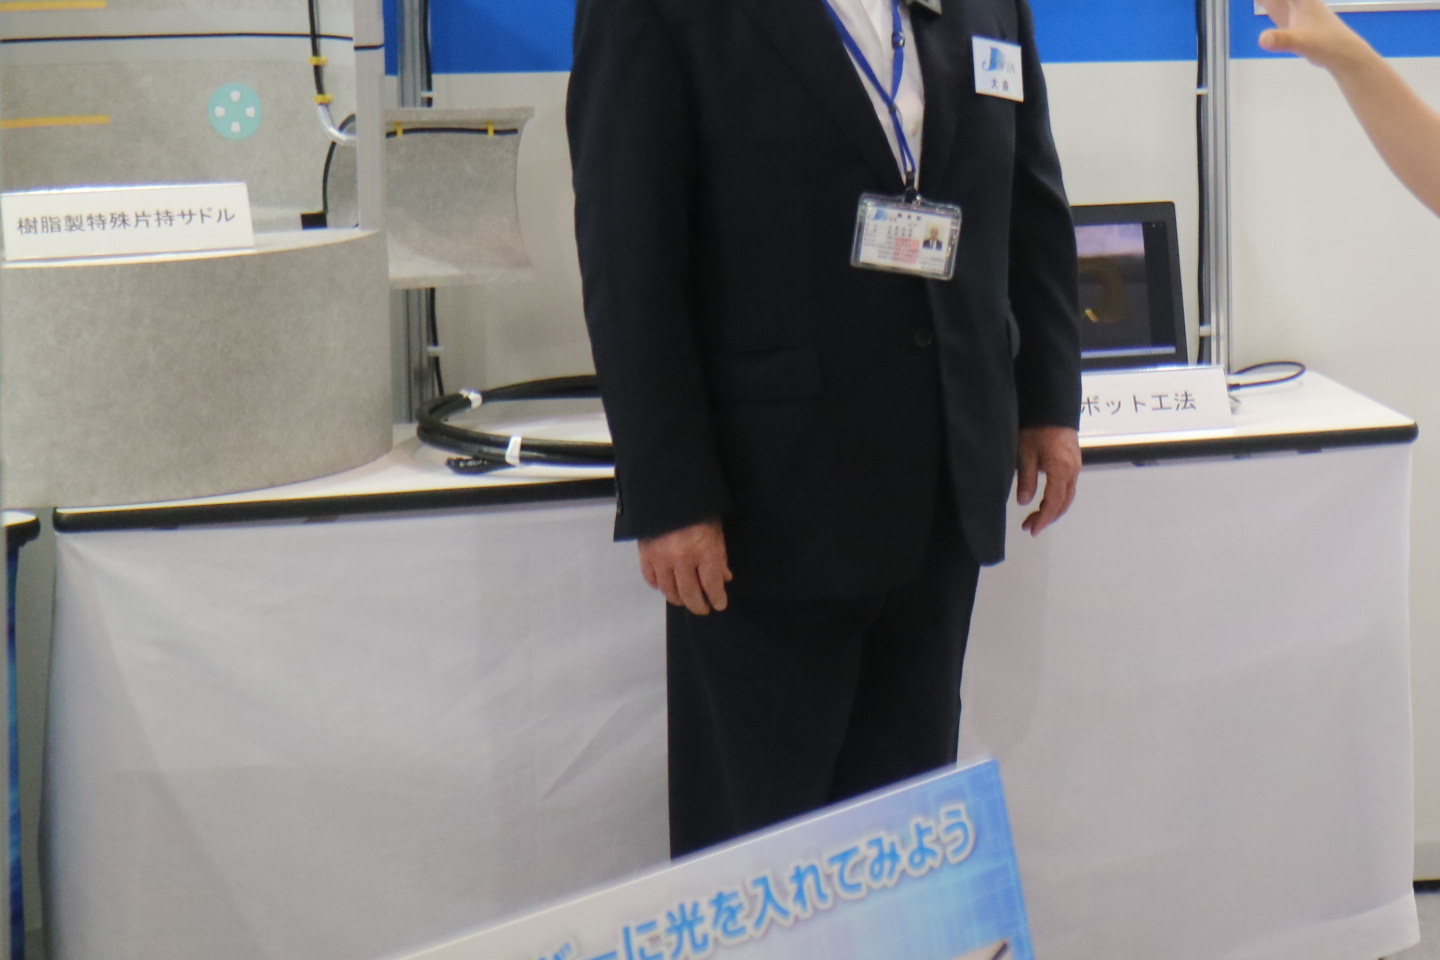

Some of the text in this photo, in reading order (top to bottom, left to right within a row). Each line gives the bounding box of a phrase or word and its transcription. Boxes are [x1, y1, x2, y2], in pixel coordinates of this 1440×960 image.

[17, 208, 235, 235] 樹脂製特殊片持サドル
